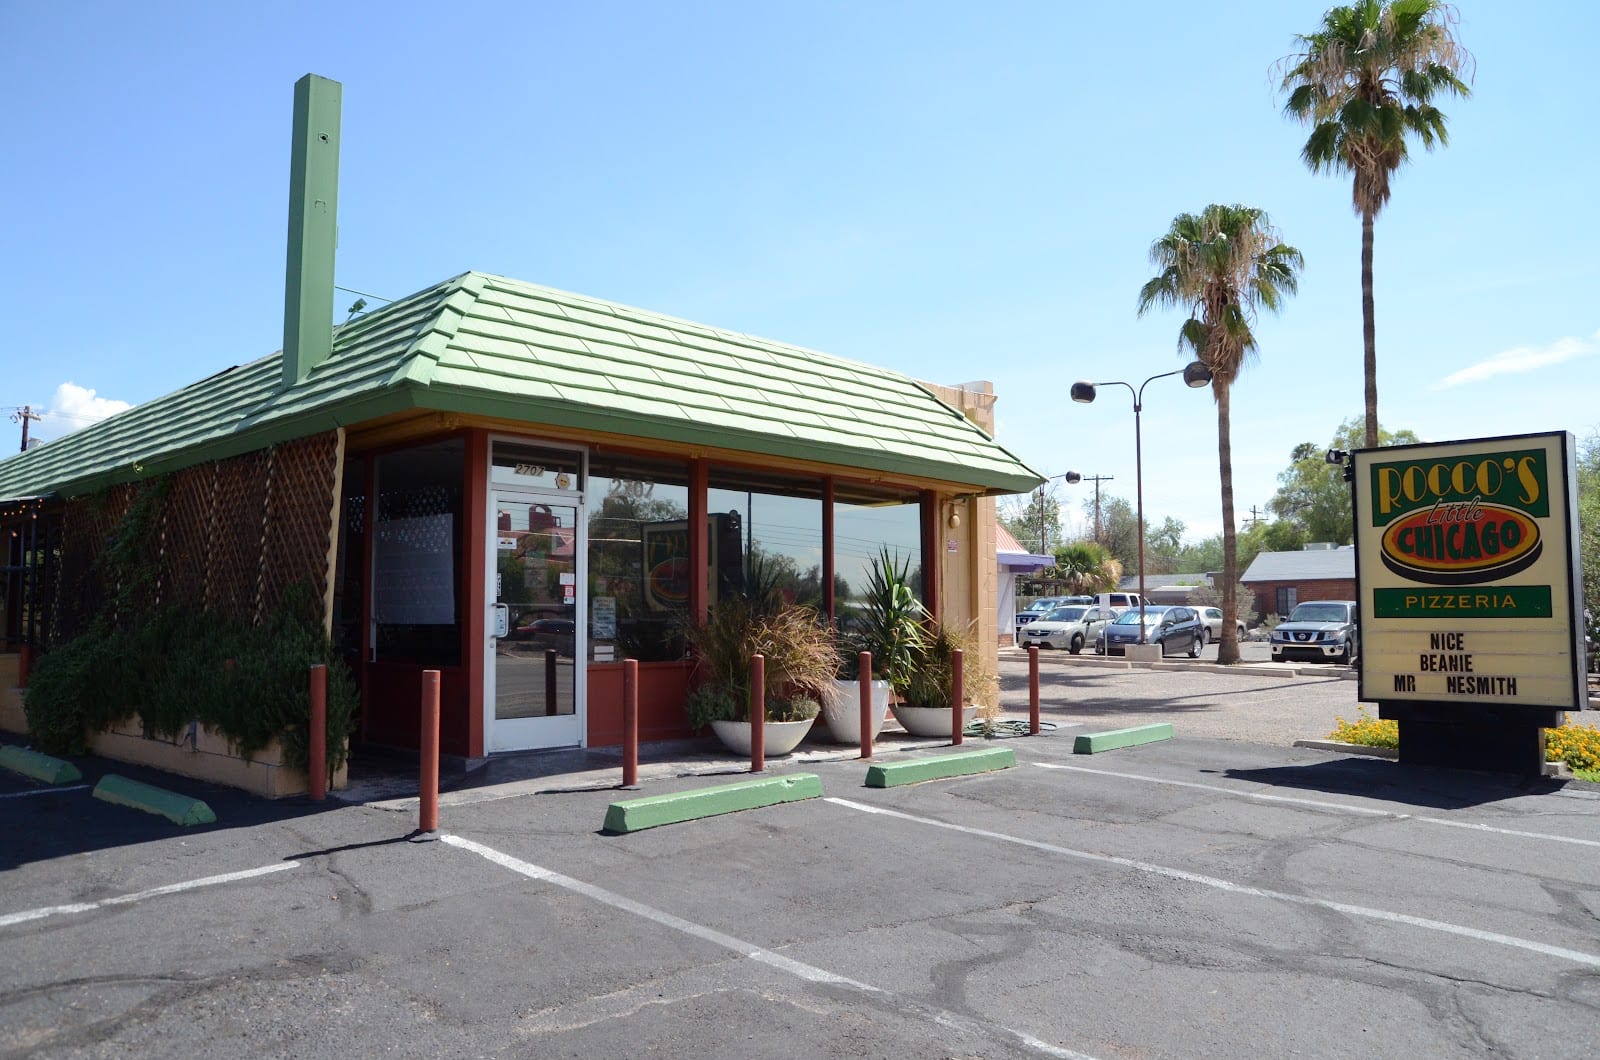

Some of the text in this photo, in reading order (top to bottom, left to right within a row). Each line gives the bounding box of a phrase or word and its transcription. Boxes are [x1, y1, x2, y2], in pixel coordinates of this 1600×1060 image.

[515, 464, 544, 476] 2707
[1379, 457, 1539, 513] ROCCO'S
[1428, 495, 1485, 523] Little
[1399, 520, 1521, 560] CHICAGO
[1406, 594, 1516, 609] PIZZERIA
[1430, 633, 1465, 651] NICE
[1420, 654, 1473, 672] BEANIE
[1394, 675, 1517, 696] MR NESMITH
